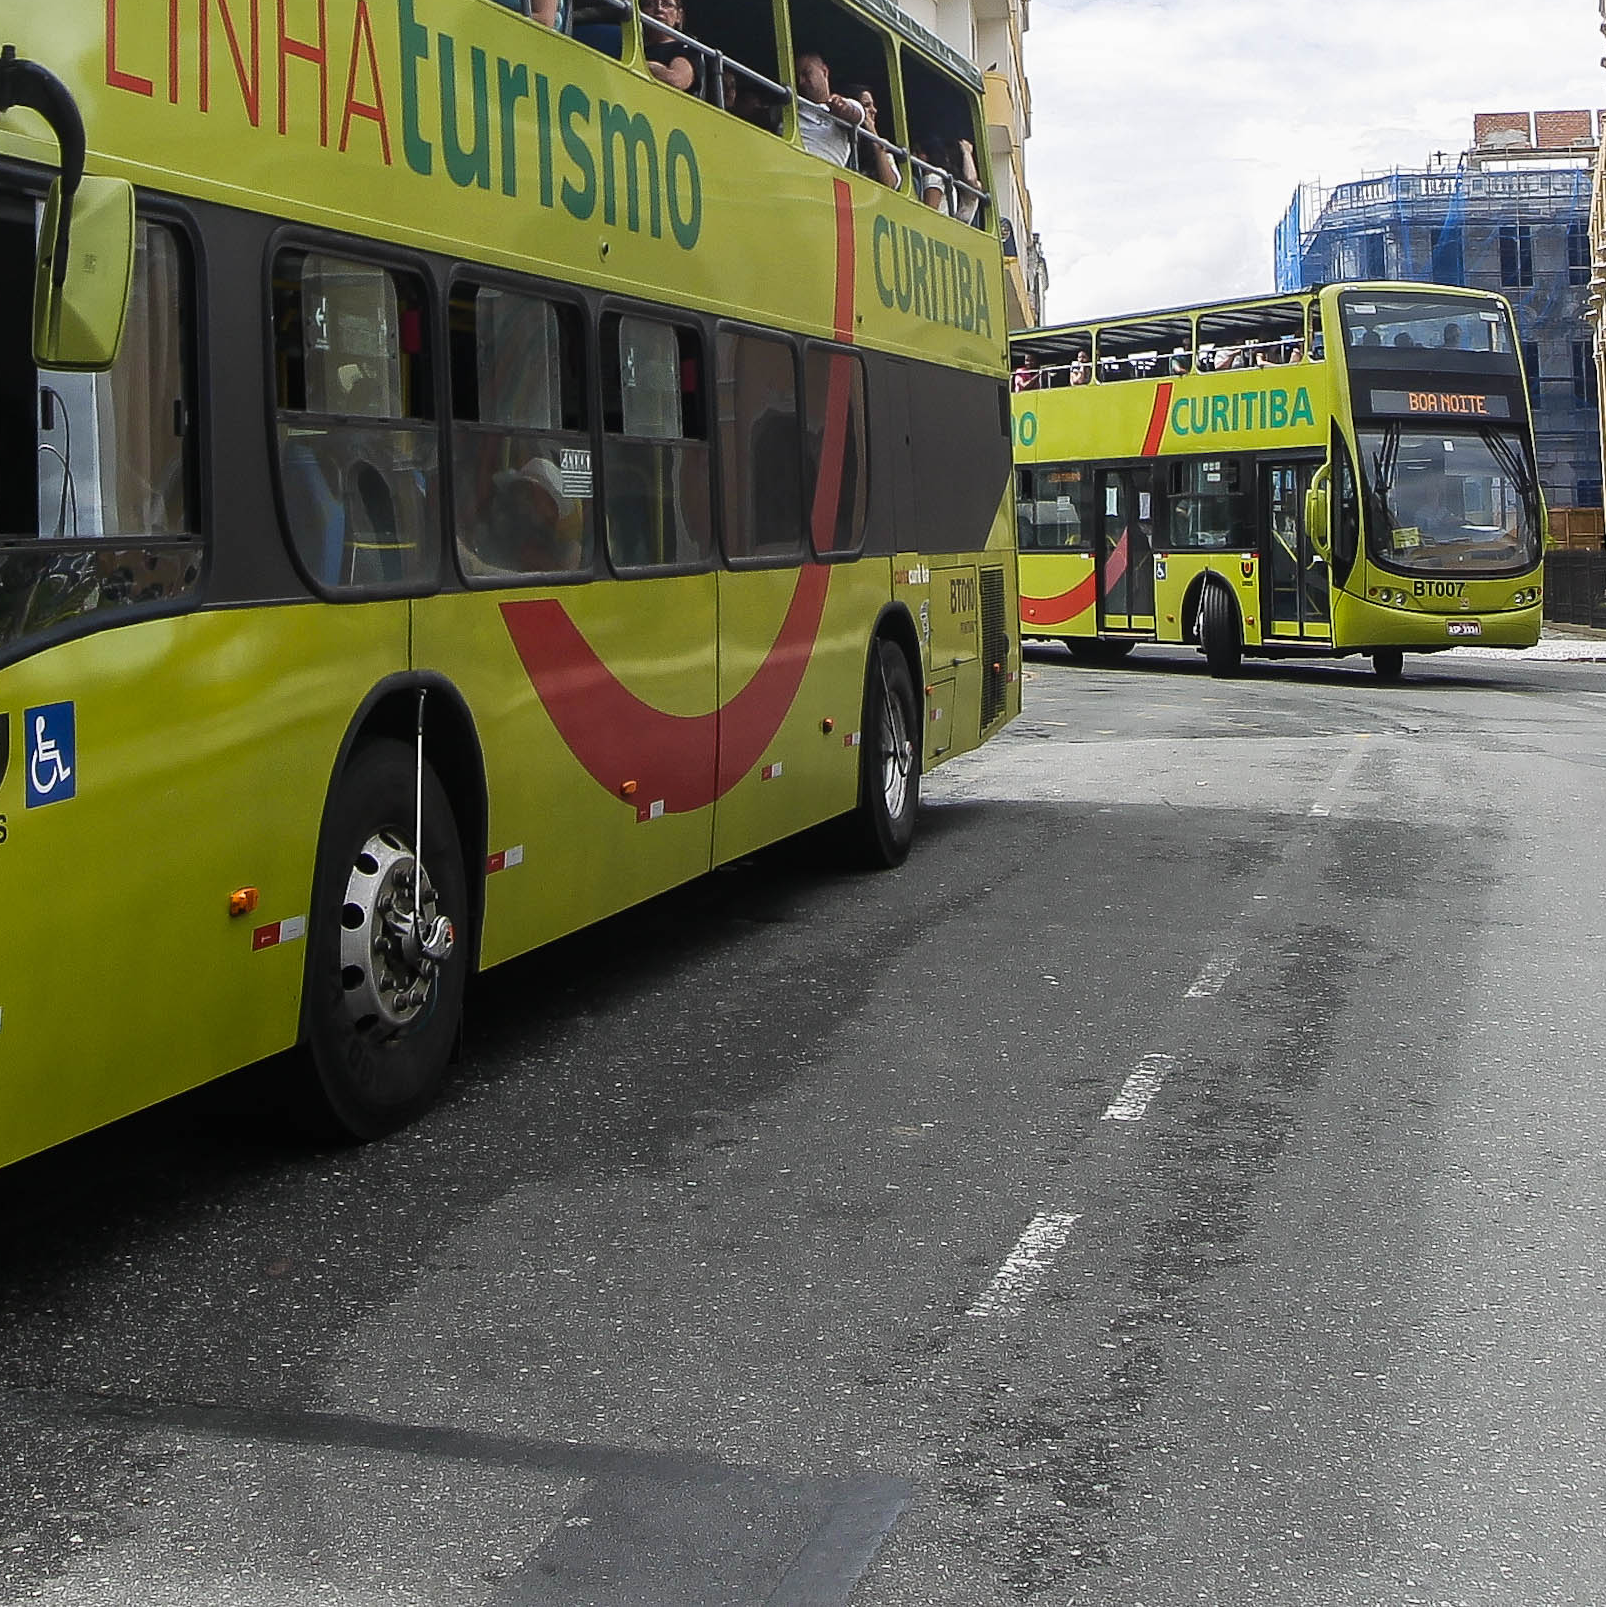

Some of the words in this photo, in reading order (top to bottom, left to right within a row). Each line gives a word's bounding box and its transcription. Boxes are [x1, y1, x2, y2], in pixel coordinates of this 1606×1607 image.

[873, 214, 992, 339] CURITIBA
[1171, 387, 1314, 436] CURITIBA
[1409, 393, 1438, 412] BOA
[1440, 394, 1487, 414] NOITE
[1413, 580, 1466, 598] BT007
